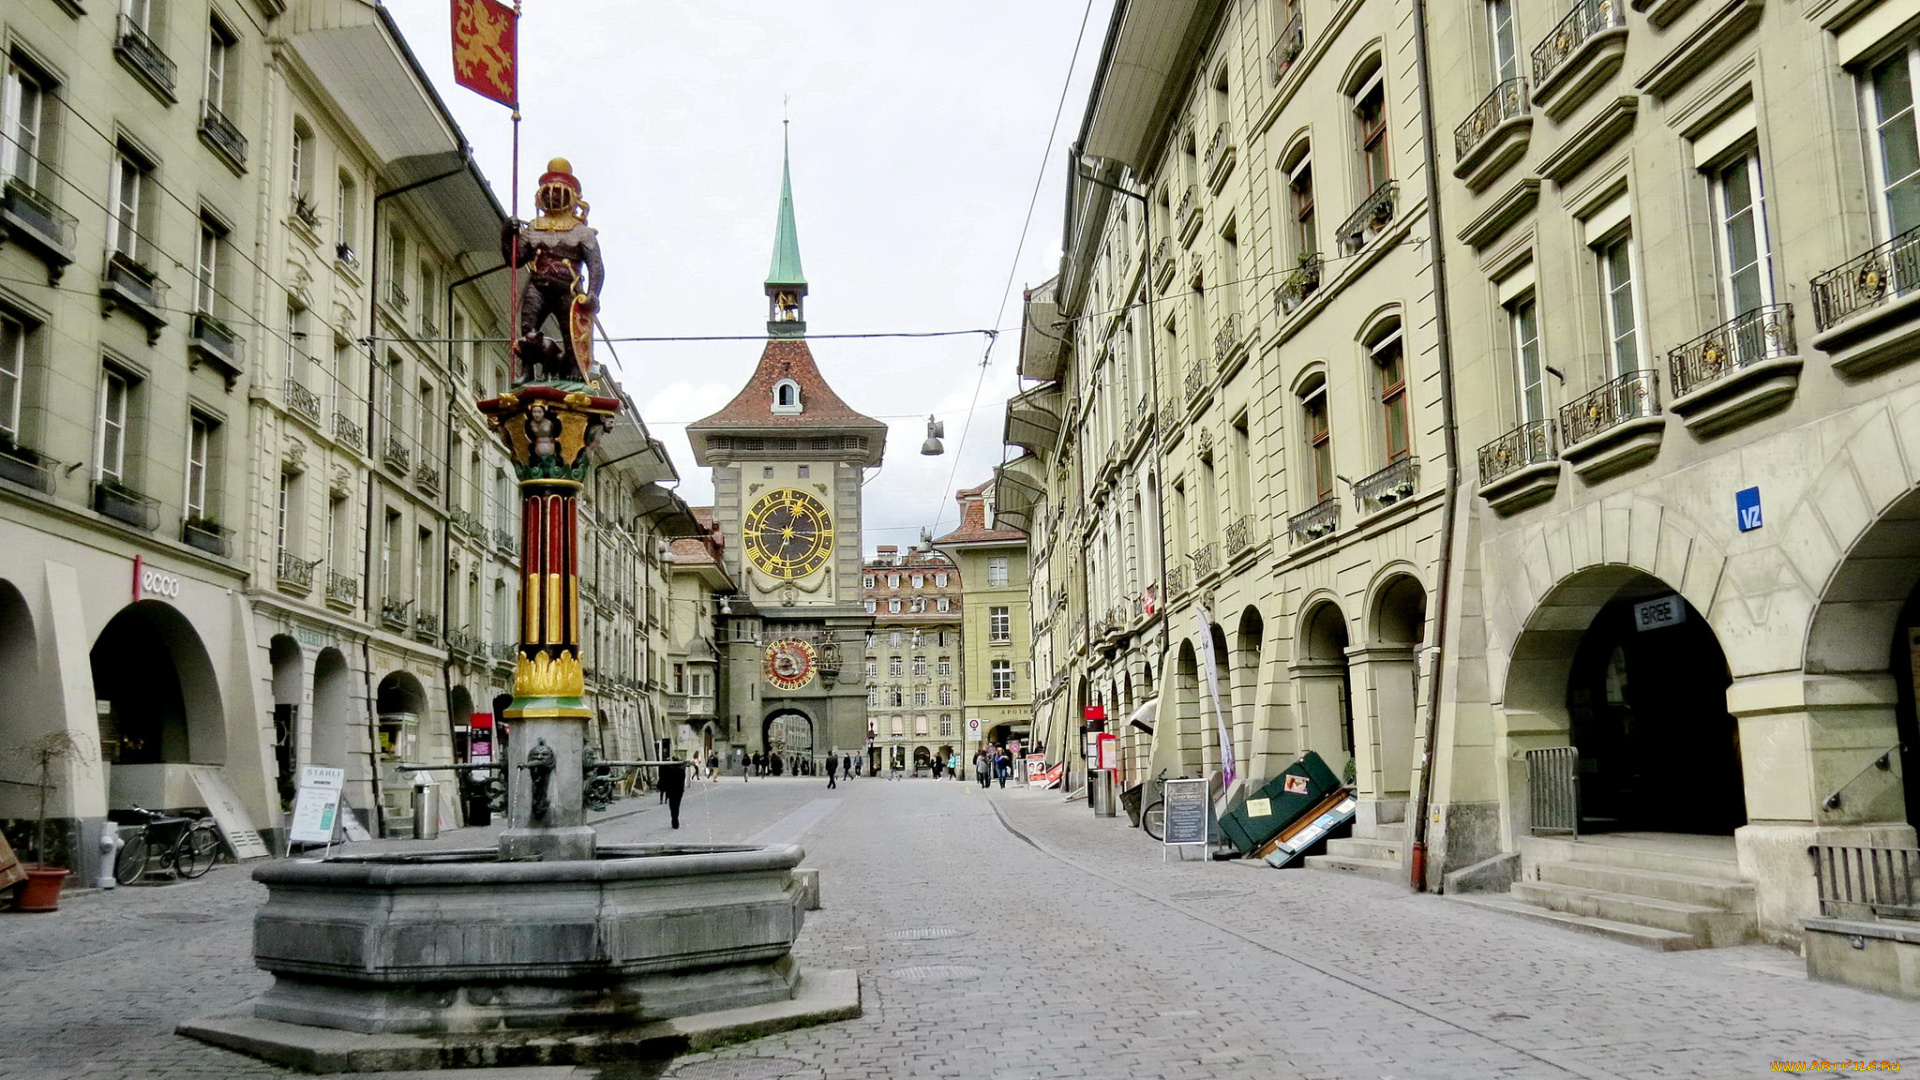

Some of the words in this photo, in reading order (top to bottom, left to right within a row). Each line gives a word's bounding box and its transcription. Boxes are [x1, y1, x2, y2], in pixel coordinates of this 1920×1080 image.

[1741, 505, 1761, 530] VZ
[143, 571, 179, 598] ecco
[1641, 602, 1672, 625] BREE
